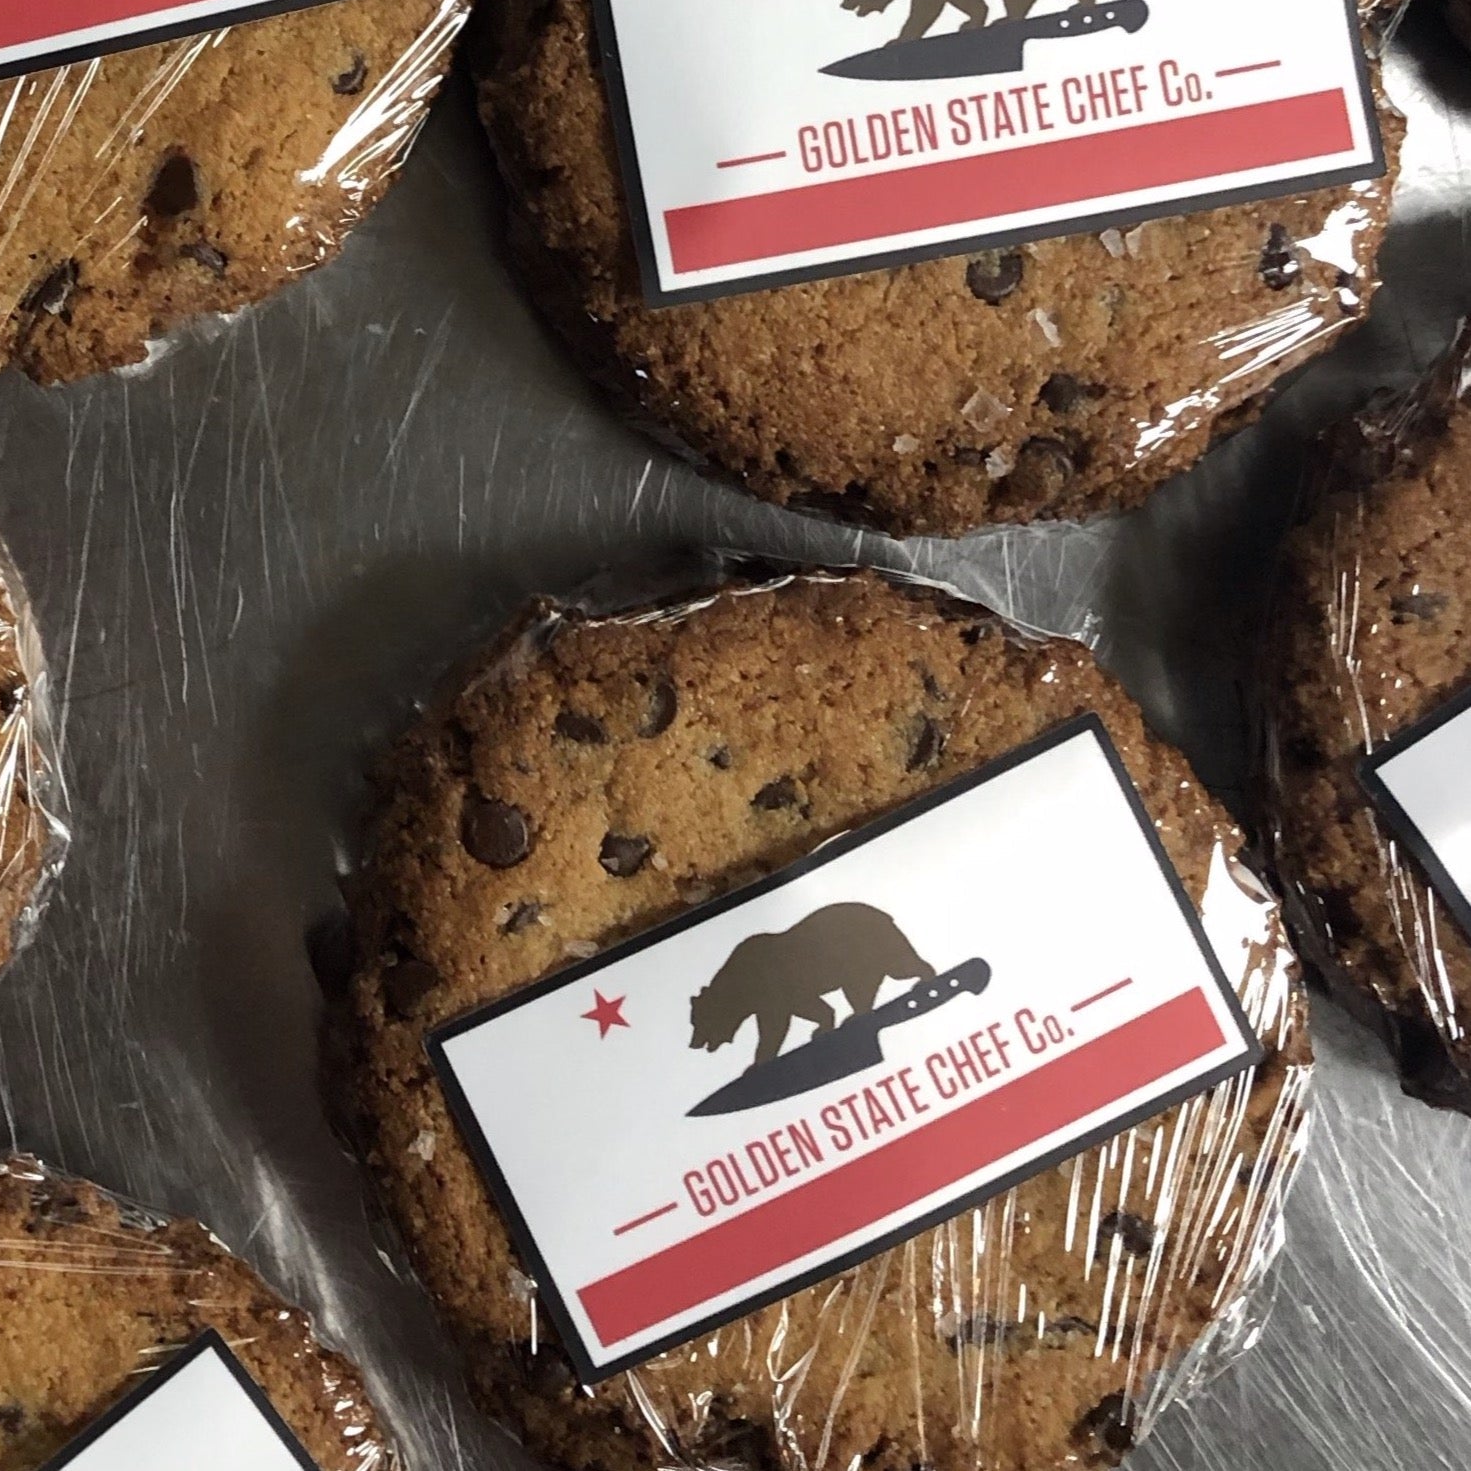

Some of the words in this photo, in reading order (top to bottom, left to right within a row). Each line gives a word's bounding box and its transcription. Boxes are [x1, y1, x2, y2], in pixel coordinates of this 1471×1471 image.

[797, 104, 940, 173] GOLDEN
[947, 83, 1054, 146] STATE
[1061, 65, 1147, 124] CHEF
[683, 1119, 825, 1219] GOLDEN
[820, 1067, 930, 1152] STATE
[925, 1023, 1010, 1100] CHEF
